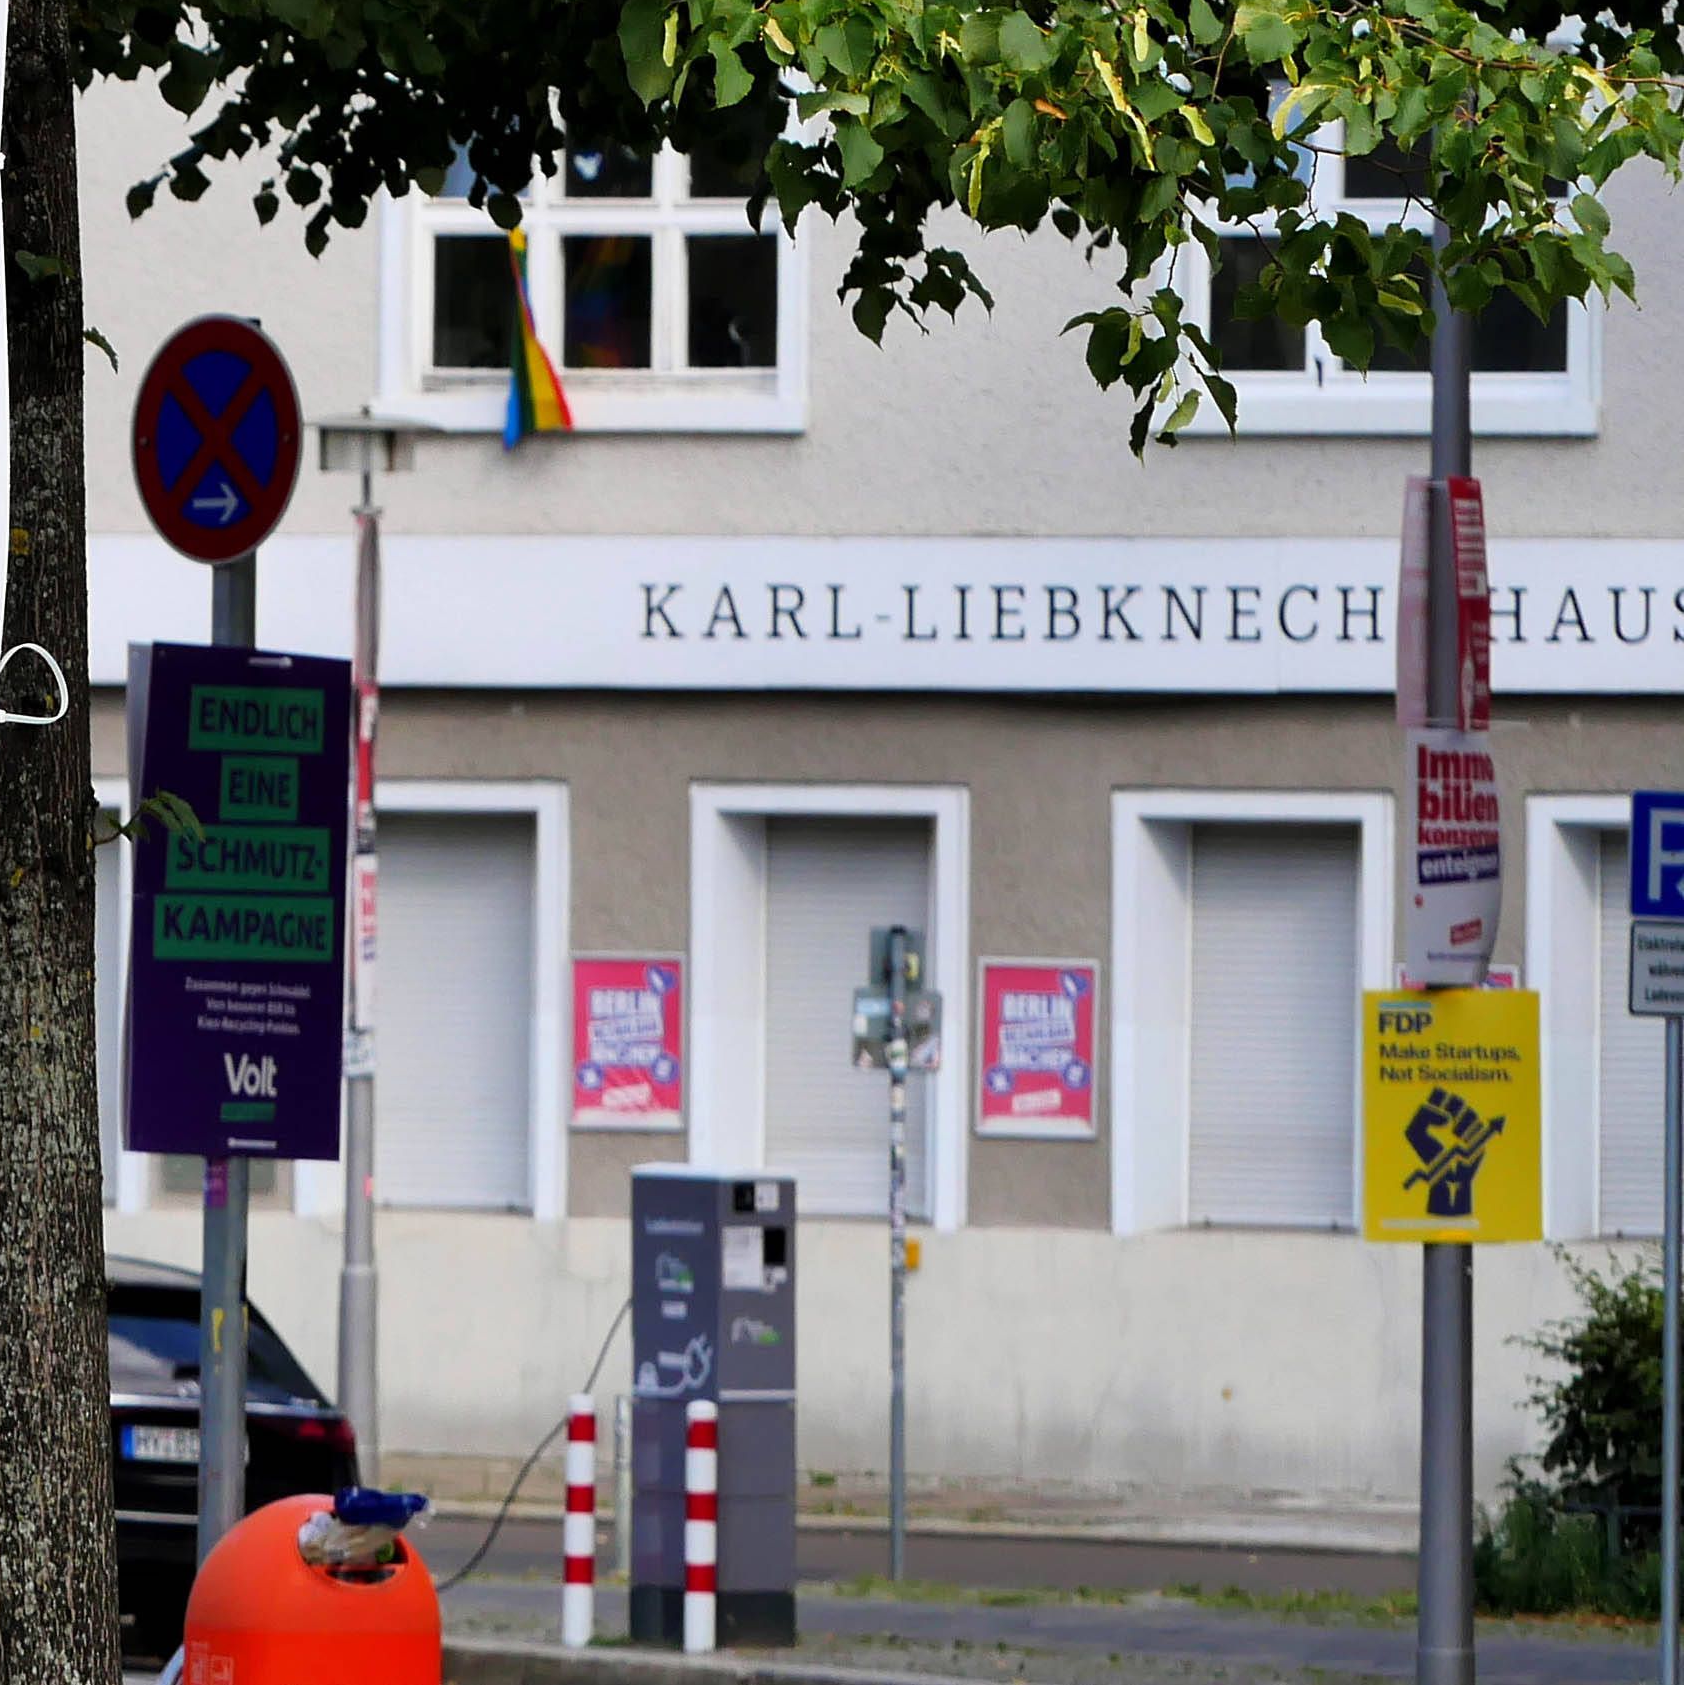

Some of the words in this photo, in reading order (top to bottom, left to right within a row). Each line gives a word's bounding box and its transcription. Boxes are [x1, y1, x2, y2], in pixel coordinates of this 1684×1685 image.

[198, 696, 318, 741] ENDLICH
[228, 769, 292, 808] EINE
[1417, 784, 1499, 821] bilien
[175, 839, 325, 881] SCHMUTZ-
[162, 904, 328, 951] KAMPAGNE
[1378, 1012, 1432, 1034] FDP
[1380, 1043, 1430, 1059] Make
[1436, 1042, 1521, 1062] Startups,
[223, 1052, 279, 1099] Volt
[1380, 1067, 1412, 1082] Not
[1418, 1065, 1512, 1083] Socialism.
